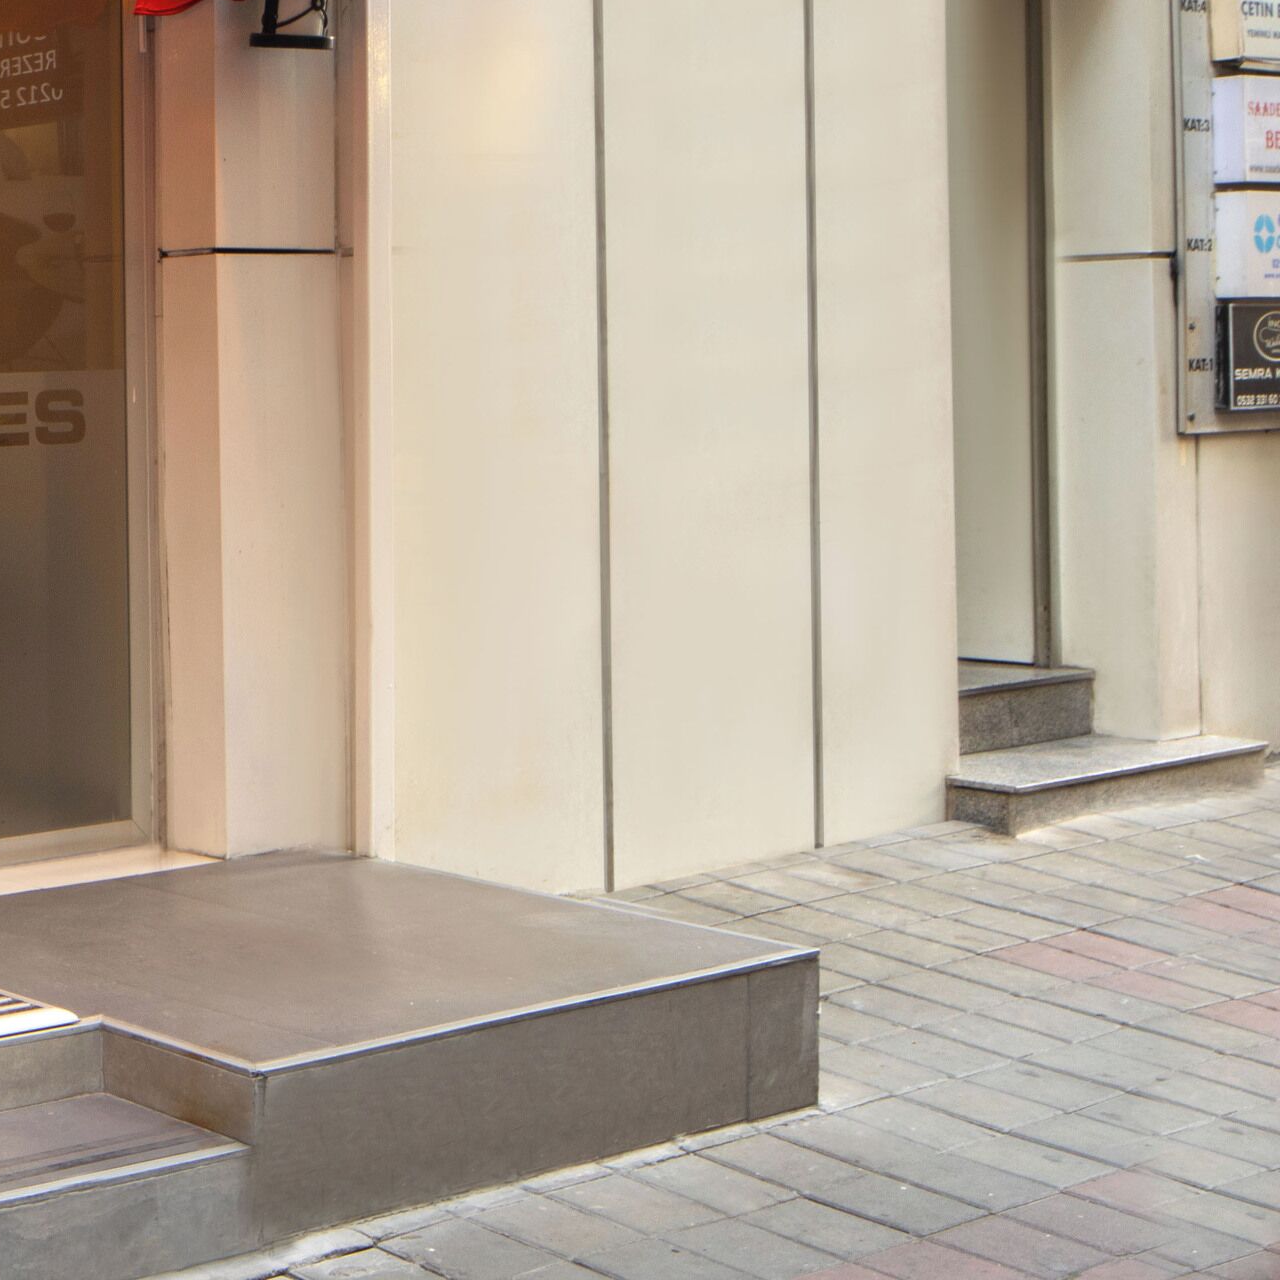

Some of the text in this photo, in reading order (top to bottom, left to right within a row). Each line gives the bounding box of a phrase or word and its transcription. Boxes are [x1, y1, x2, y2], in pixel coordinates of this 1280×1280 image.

[1180, 0, 1207, 12] KAT:4
[1186, 238, 1212, 251] KAT:2
[1188, 358, 1213, 371] KAT:1
[1235, 369, 1272, 380] SEMRA
